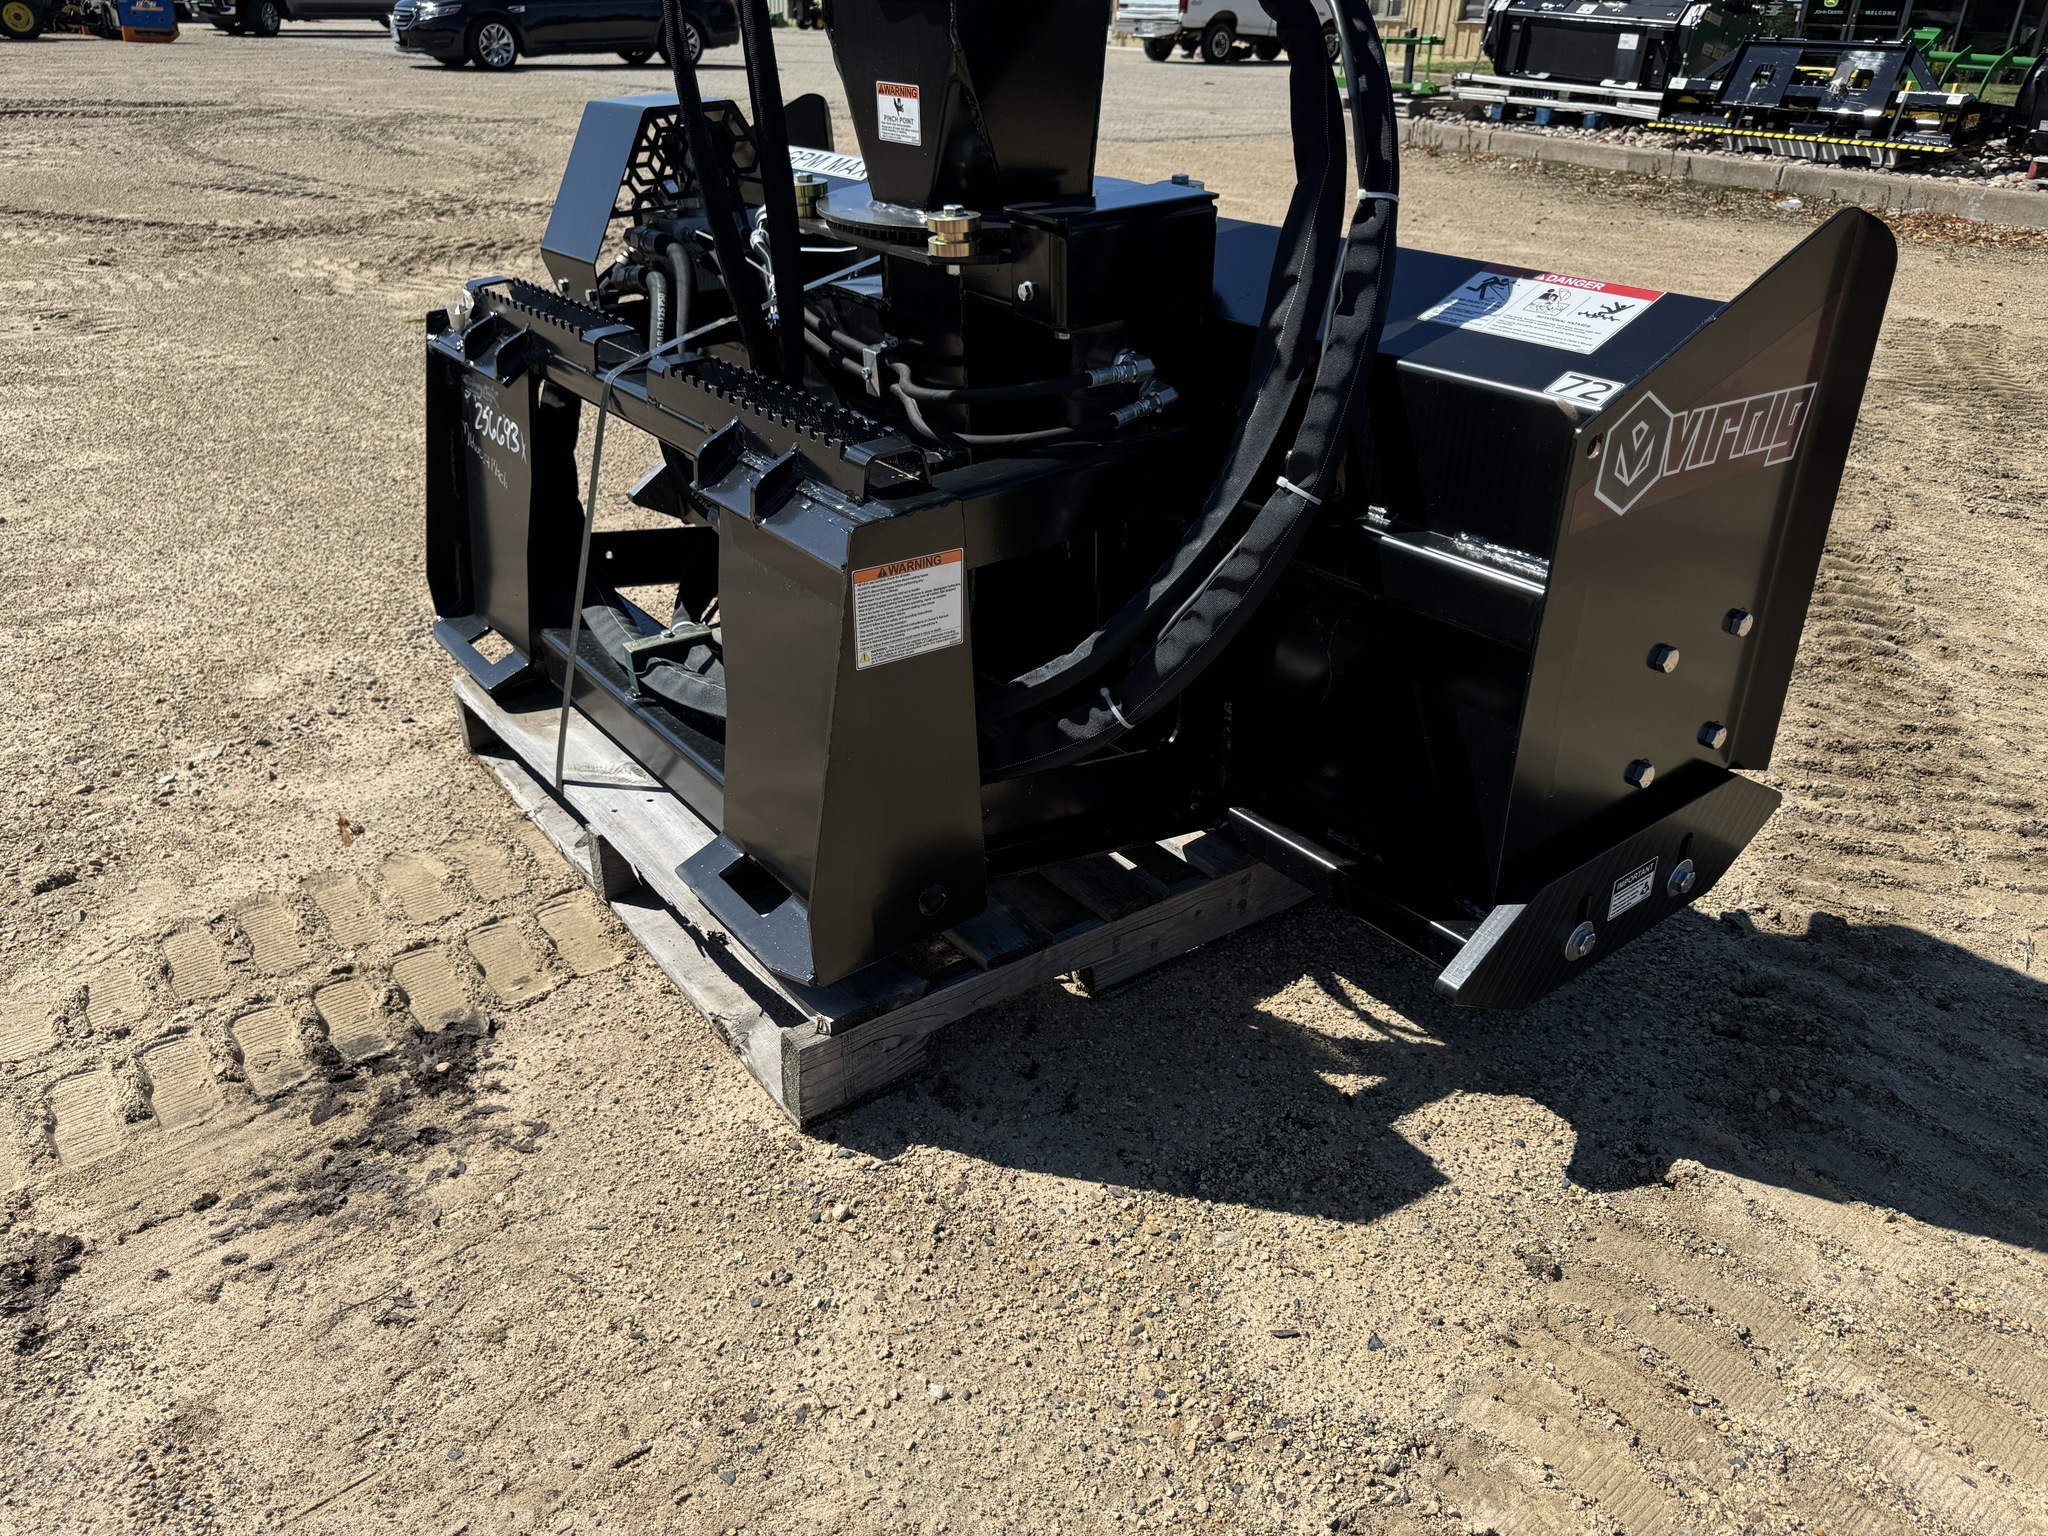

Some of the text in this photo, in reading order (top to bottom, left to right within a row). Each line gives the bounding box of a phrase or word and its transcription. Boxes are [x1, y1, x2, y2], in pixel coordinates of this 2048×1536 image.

[885, 84, 918, 98] WARNING
[883, 114, 914, 125] PINCH POINT
[1545, 273, 1605, 291] DANGER
[1556, 375, 1613, 401] 72
[888, 555, 942, 576] WARNING
[1616, 862, 1655, 891] IMPORTANT
